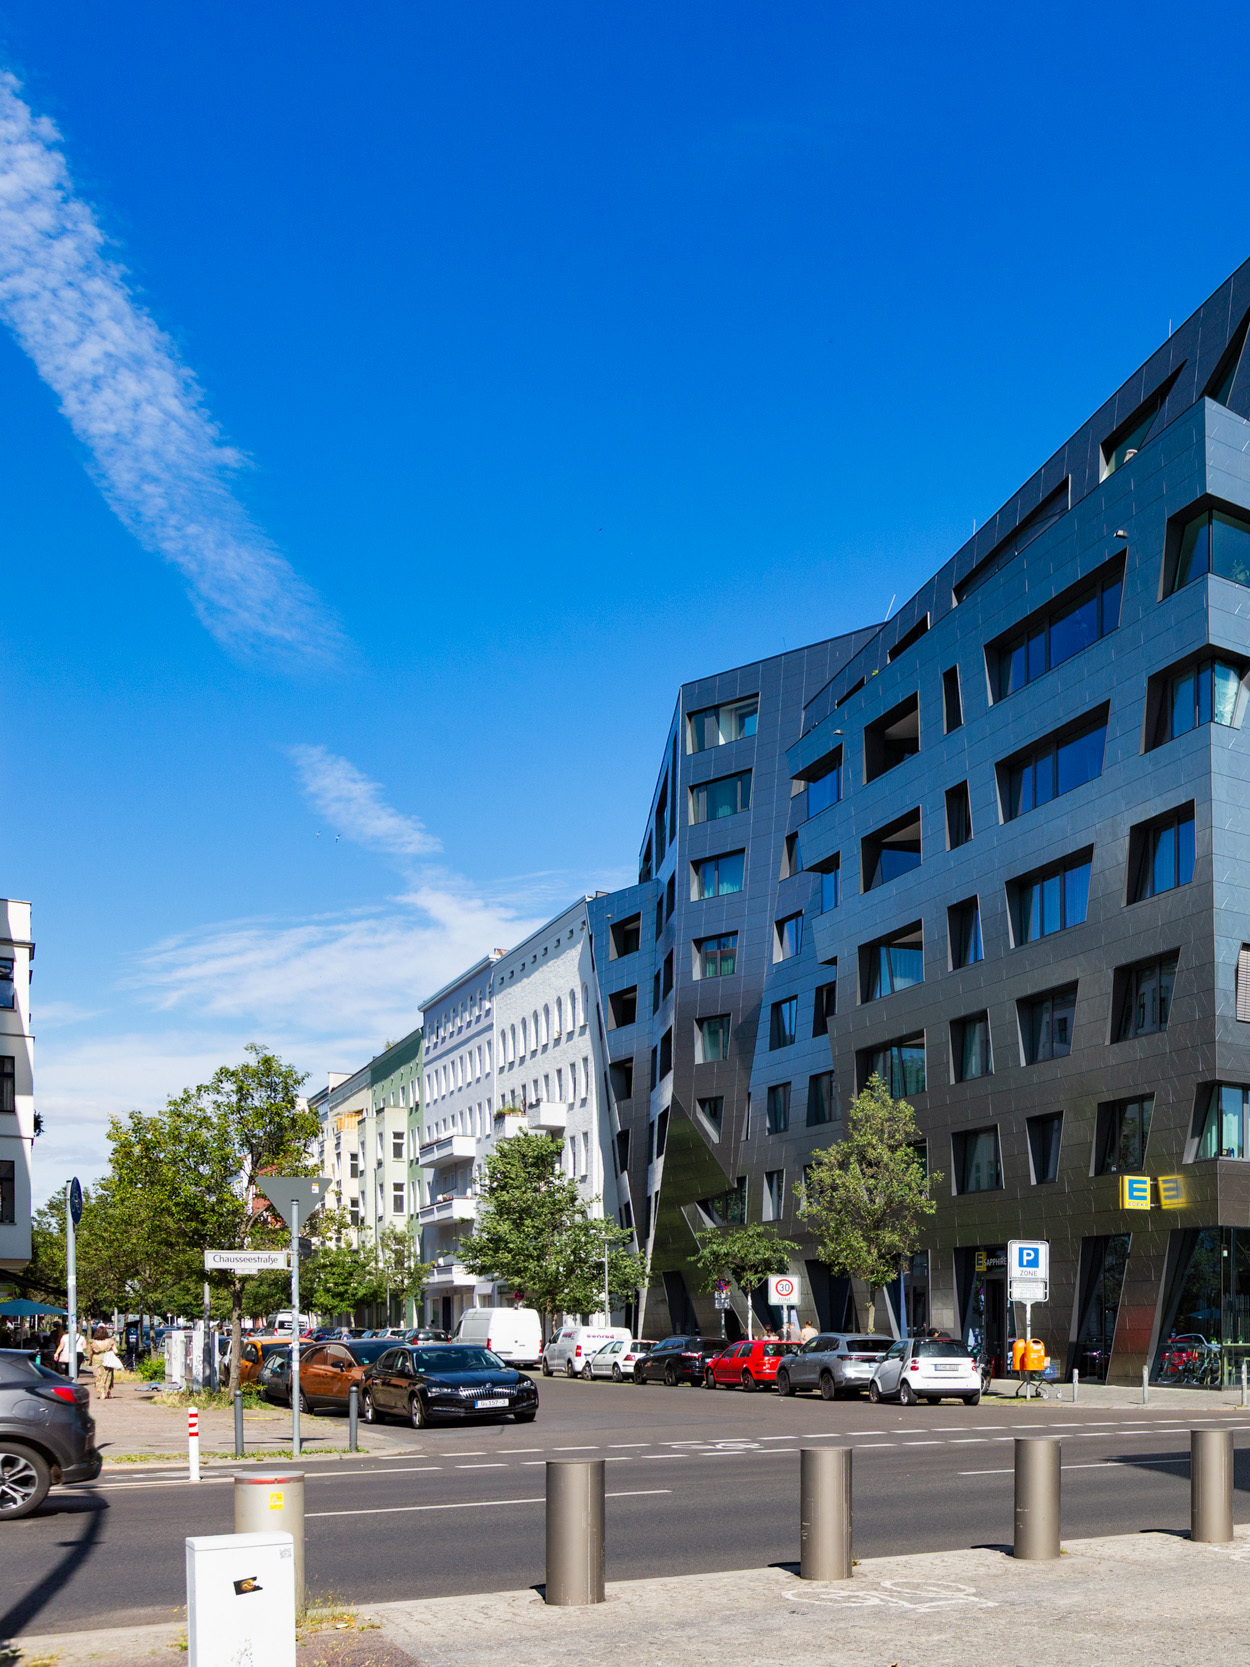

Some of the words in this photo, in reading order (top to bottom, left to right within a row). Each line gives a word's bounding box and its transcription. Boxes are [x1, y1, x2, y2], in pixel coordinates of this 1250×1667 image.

[1128, 1179, 1148, 1201] E
[212, 1254, 279, 1265] Chausseestraße
[984, 1258, 1007, 1267] SAPPHIRE
[1023, 1249, 1035, 1266] P
[779, 1283, 791, 1292] 30
